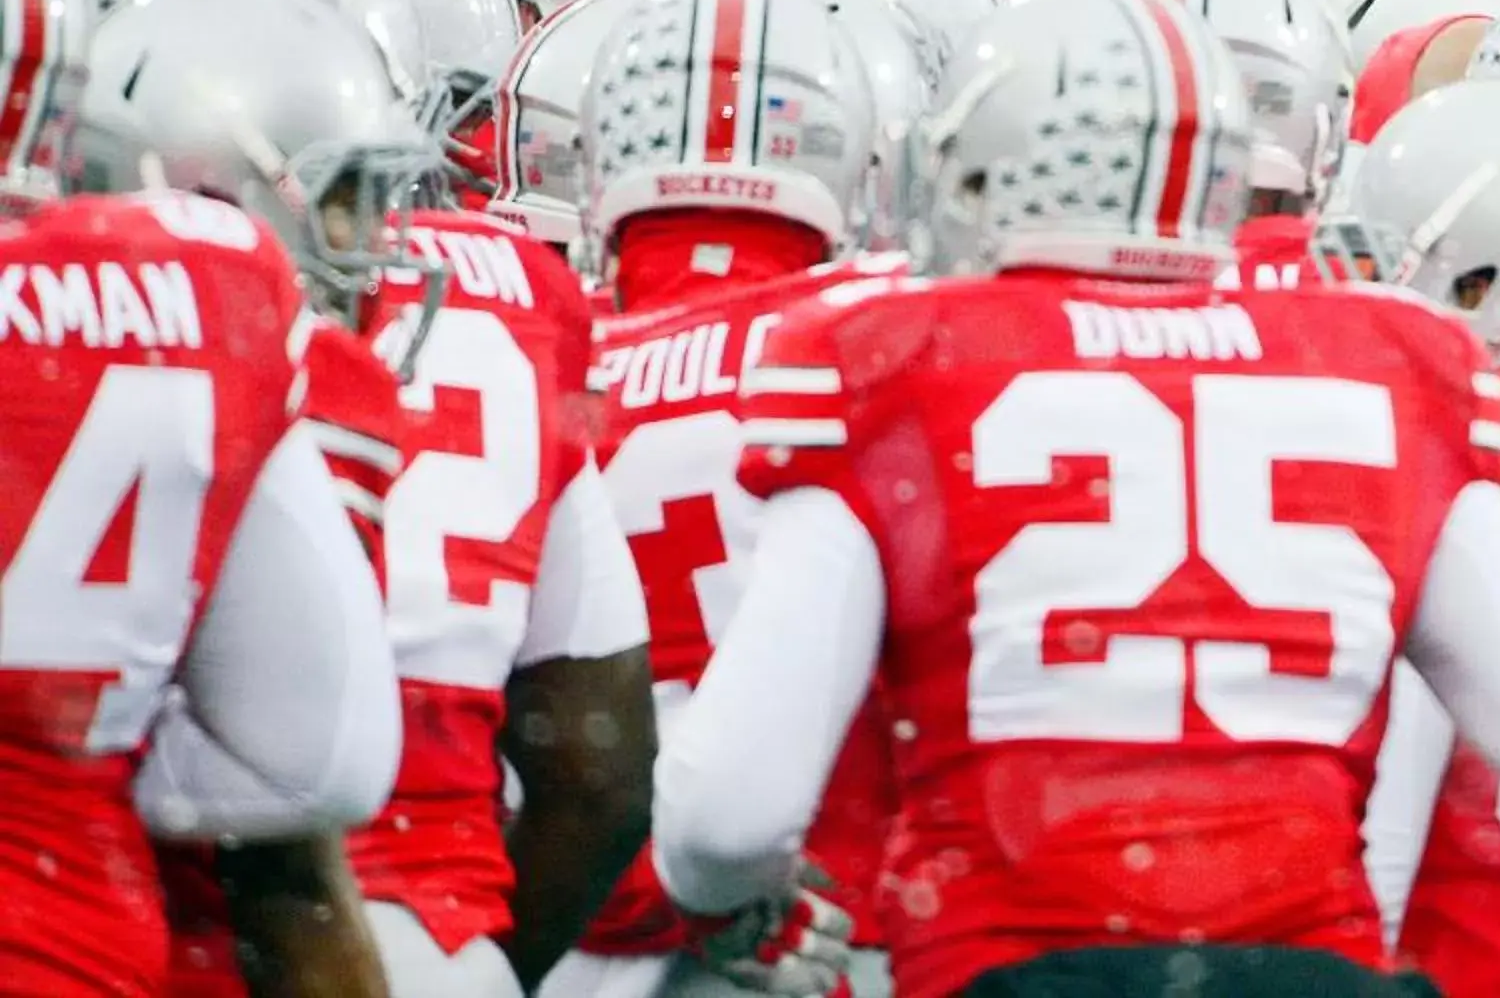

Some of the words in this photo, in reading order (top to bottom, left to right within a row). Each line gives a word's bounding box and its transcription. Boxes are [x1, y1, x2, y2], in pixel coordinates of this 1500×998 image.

[1062, 299, 1263, 360] DUNN
[0, 364, 216, 754] 4
[967, 370, 1398, 746] 25
